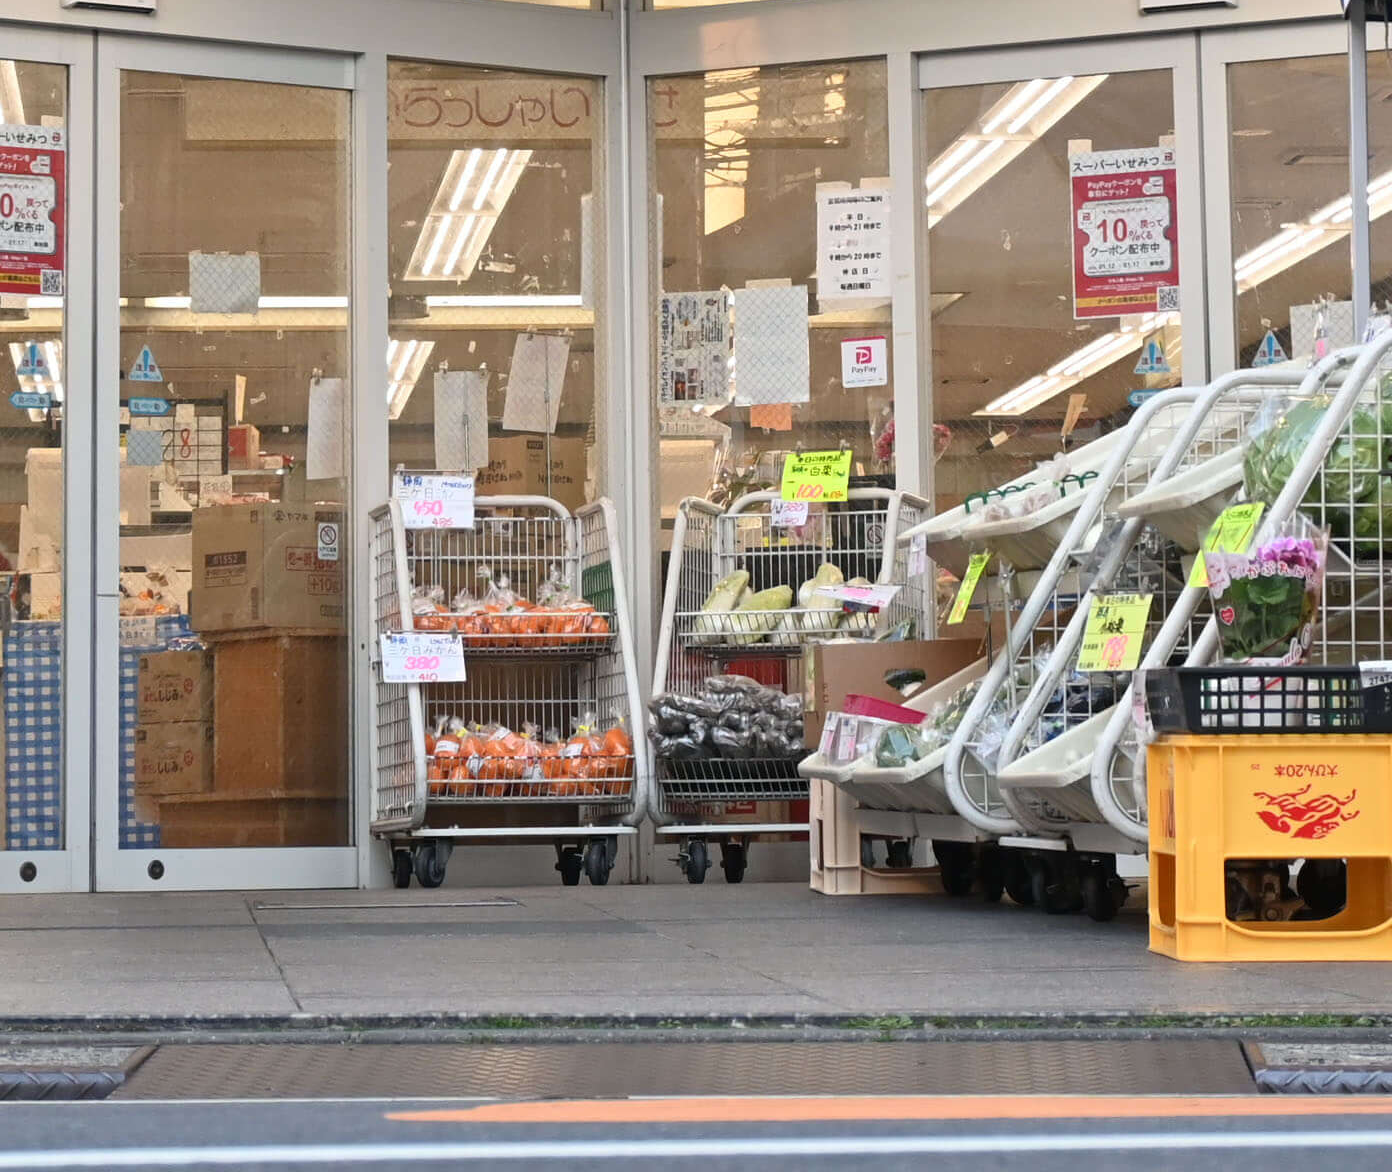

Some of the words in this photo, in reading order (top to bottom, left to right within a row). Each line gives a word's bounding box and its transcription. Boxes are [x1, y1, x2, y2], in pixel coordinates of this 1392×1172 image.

[1073, 157, 1160, 173] スーパーいせみつ
[1090, 243, 1161, 258] クーポン配布中
[851, 365, 877, 375] PayPay
[796, 484, 824, 499] 100
[1273, 763, 1339, 778] 大びん20本
